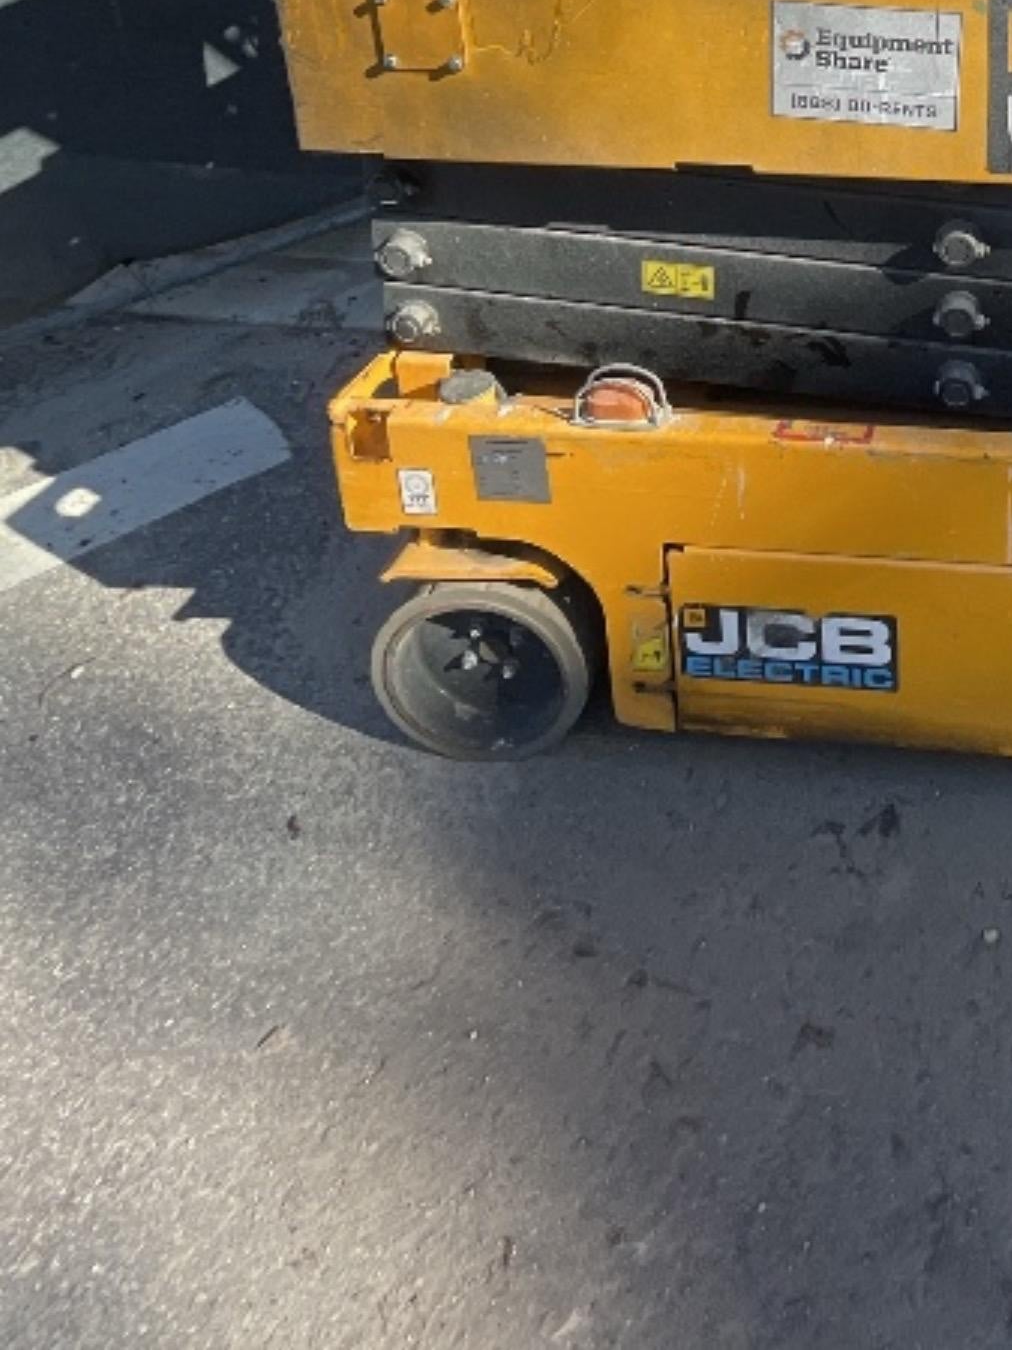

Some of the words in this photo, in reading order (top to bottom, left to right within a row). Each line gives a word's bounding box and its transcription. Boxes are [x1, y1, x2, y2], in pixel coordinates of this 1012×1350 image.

[815, 27, 954, 55] Equipment
[815, 50, 889, 73] Share
[684, 608, 893, 667] JCB
[686, 655, 893, 688] ELECTRIC
